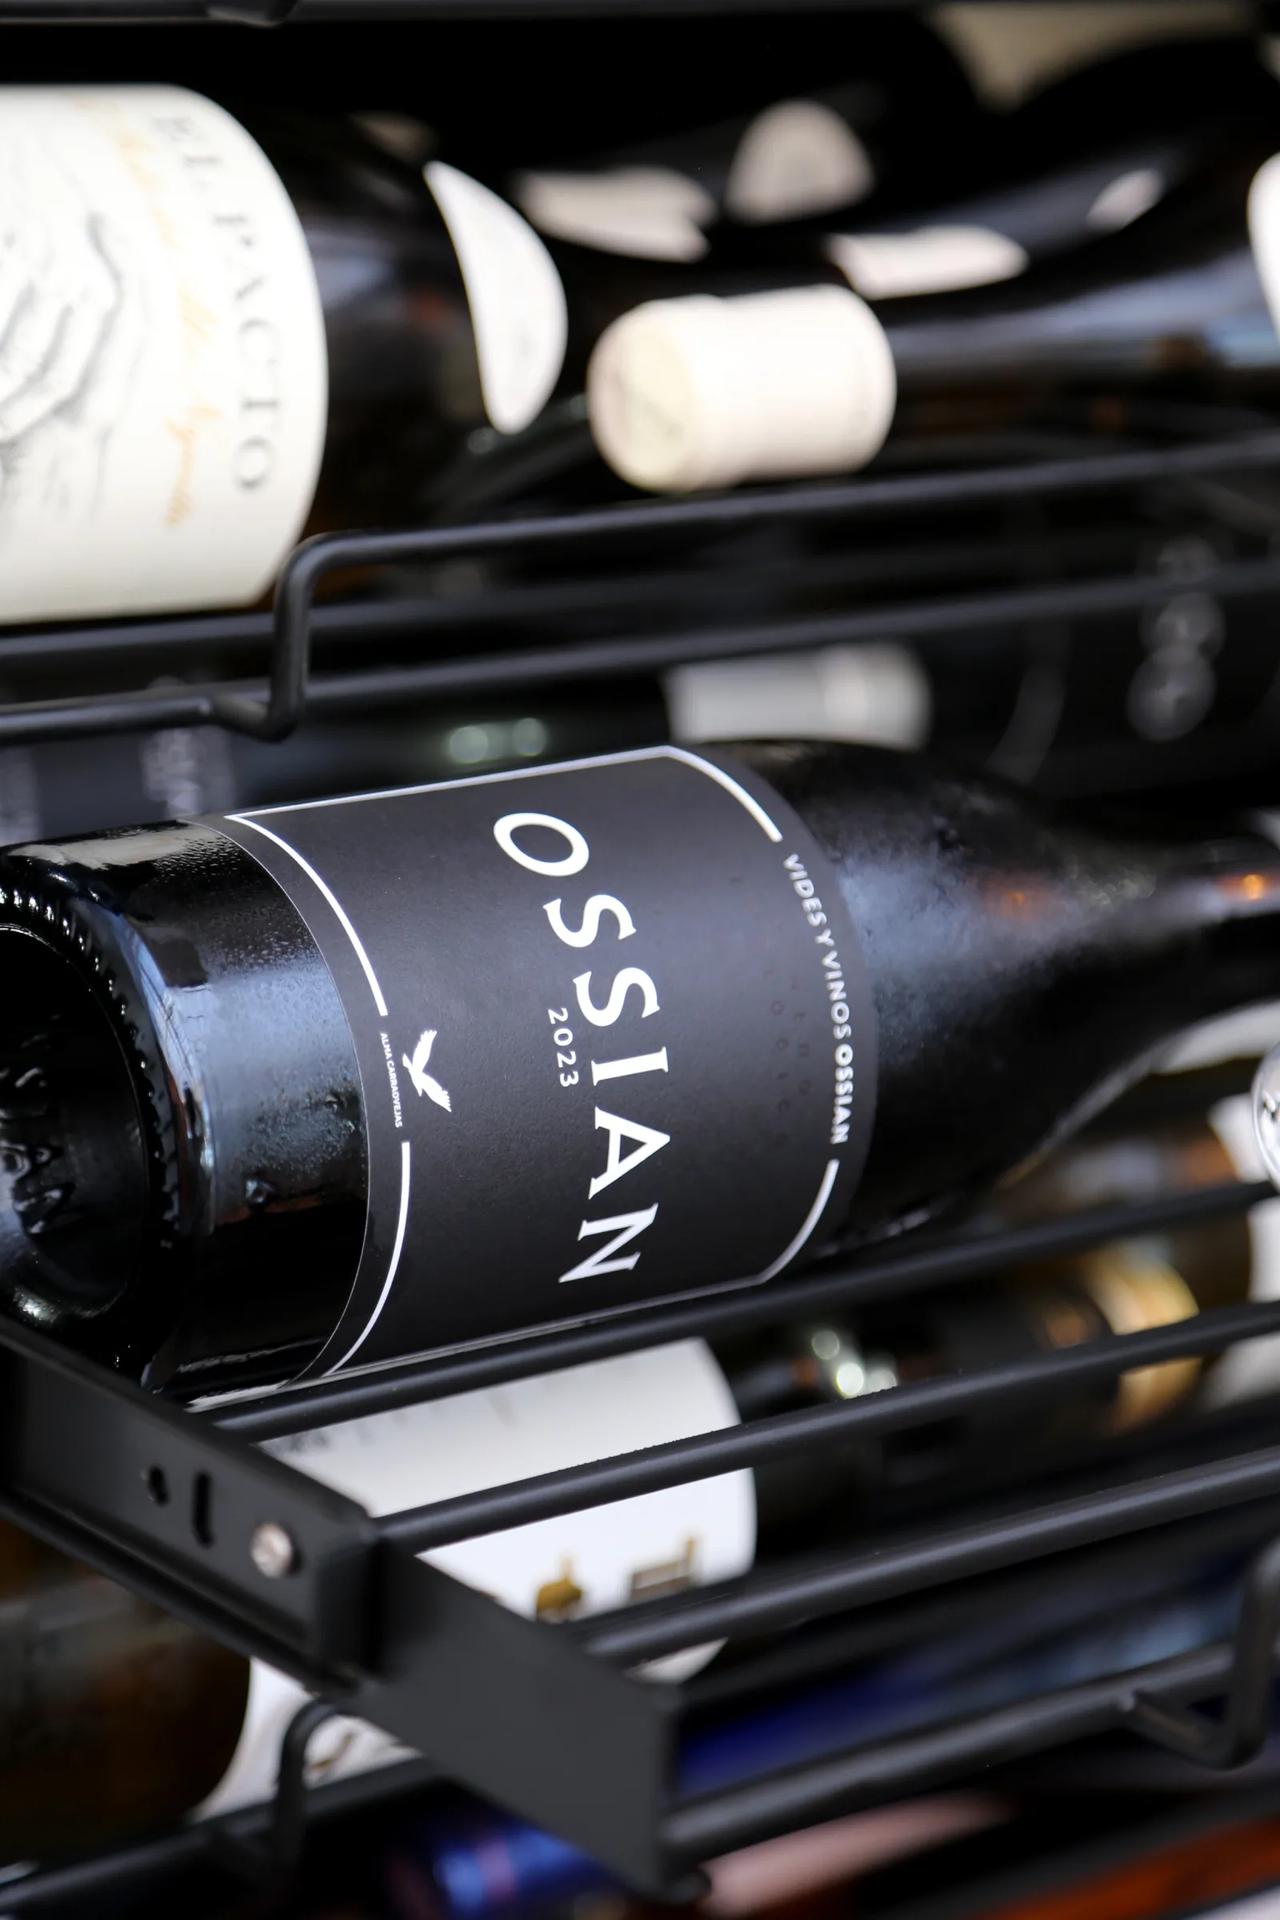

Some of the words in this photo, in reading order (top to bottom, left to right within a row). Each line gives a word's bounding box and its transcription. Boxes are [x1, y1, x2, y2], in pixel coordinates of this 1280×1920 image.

[212, 211, 284, 492] PACTO
[783, 853, 829, 926] VIDES
[816, 929, 836, 947] Y
[822, 950, 853, 1040] VINOS
[379, 1032, 394, 1060] ALMA
[493, 812, 671, 1284] OSSIAN
[547, 1007, 581, 1088] 2023
[386, 1058, 404, 1129] CARRAOVEJAS
[830, 1043, 855, 1145] OSSIAN
